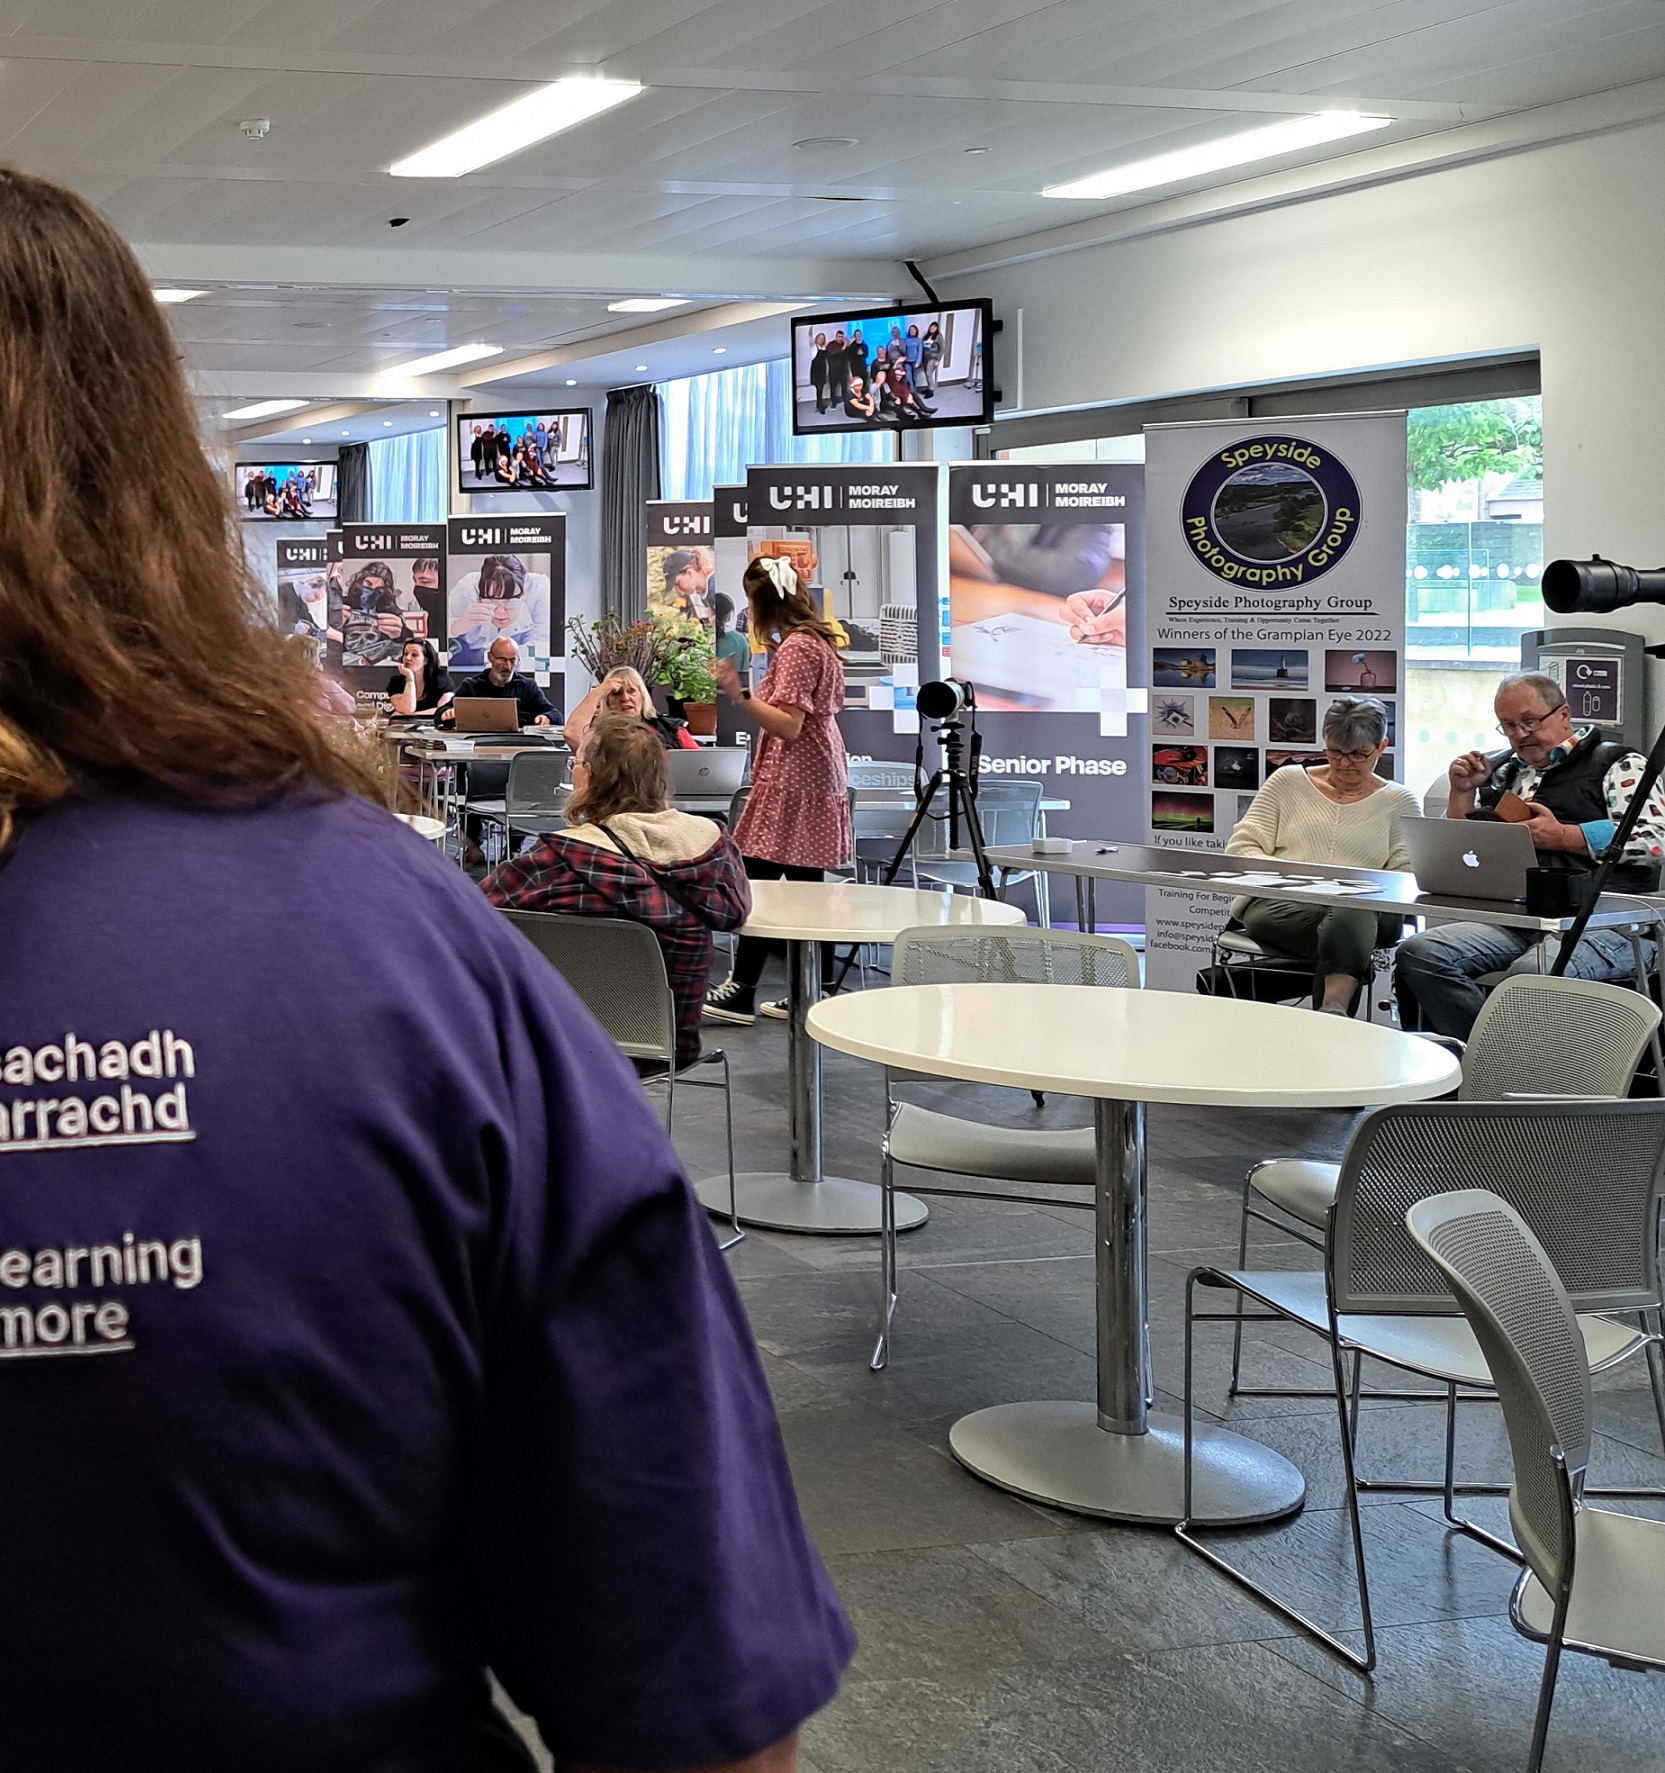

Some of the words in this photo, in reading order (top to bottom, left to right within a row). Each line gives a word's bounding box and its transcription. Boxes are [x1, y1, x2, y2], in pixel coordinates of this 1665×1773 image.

[1221, 441, 1321, 469] Speyside
[849, 484, 899, 496] MORAY
[972, 483, 1039, 508] UHI
[1055, 482, 1108, 495] MORAY
[769, 485, 832, 510] UHI
[849, 496, 916, 510] MOIREIBH
[1055, 495, 1126, 508] MOIREIBH
[510, 527, 541, 536] MORAY
[663, 516, 710, 534] UHI
[355, 535, 392, 550] UHI
[400, 534, 429, 543] MORAY
[461, 528, 501, 545] UHI
[510, 535, 552, 544] MOIREIBH
[1186, 516, 1304, 586] Photography
[1307, 507, 1355, 566] Group
[286, 548, 317, 561] UHI
[1169, 596, 1229, 610] Speyside
[1234, 596, 1322, 611] Photography
[1327, 596, 1372, 611] Group
[1158, 628, 1211, 640] Winners
[1214, 627, 1228, 640] of
[1231, 628, 1253, 641] the
[1257, 628, 1324, 643] Grampian
[1328, 629, 1352, 644] Eye
[1356, 629, 1392, 642] 2022
[978, 754, 1050, 775] Senior
[1055, 754, 1126, 775] Phase
[853, 772, 915, 787] ceships
[1154, 835, 1161, 844] If
[1163, 838, 1182, 847] you
[1185, 837, 1203, 847] like
[1206, 840, 1227, 848] taki
[1159, 889, 1194, 900] Training
[1196, 892, 1210, 900] For
[1189, 906, 1230, 917] Competit
[1156, 918, 1225, 932] www.speysidep
[1157, 930, 1214, 943] info@speysid
